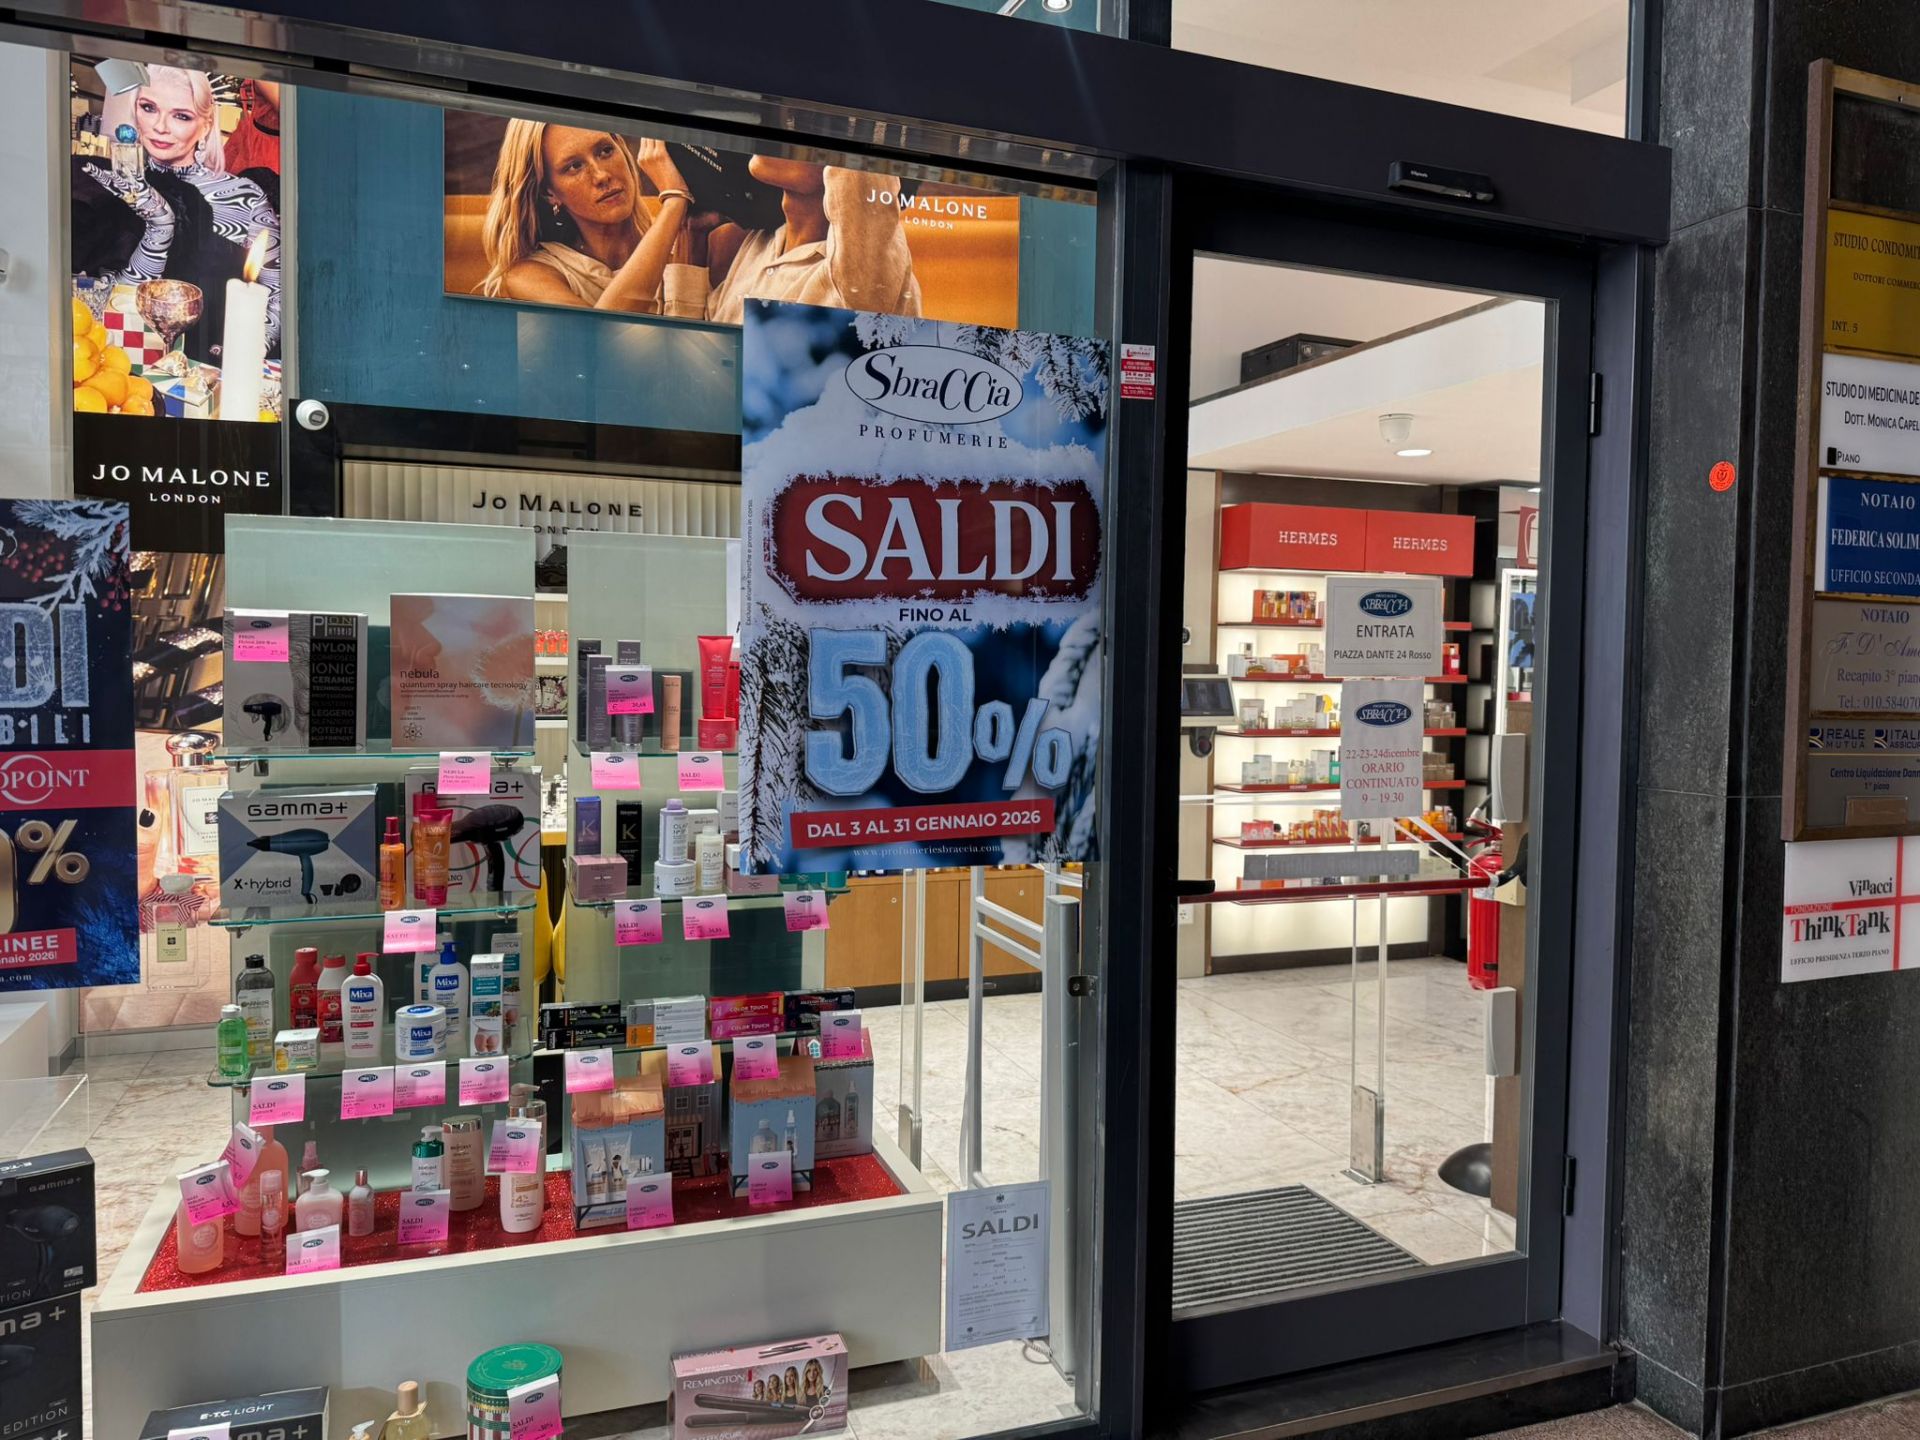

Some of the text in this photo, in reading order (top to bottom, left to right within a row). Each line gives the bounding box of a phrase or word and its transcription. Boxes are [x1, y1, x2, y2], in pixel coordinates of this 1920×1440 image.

[866, 189, 988, 219] JO MALONE
[905, 216, 954, 230] LONDON
[1833, 232, 1869, 251] STUDIO
[1832, 320, 1858, 333] INT. 5
[1825, 381, 1857, 399] STUDIO
[1858, 385, 1867, 400] DI
[1868, 386, 1909, 404] MEDICINA
[859, 423, 1009, 449] PROFUMERIE
[92, 464, 271, 488] JO MALONE
[149, 493, 222, 504] LONDON
[1860, 492, 1916, 511] NOTAIO
[804, 492, 1077, 582] SALDI
[1831, 528, 1885, 549] FEDERICA
[1831, 568, 1872, 585] UFFICIO
[899, 607, 973, 622] FINO AL
[1860, 608, 1910, 624] NOTAIO
[1356, 624, 1415, 639] ENTRATA
[311, 642, 356, 653] NYLON
[1333, 649, 1432, 661] PIAZZA DANTE 24 Rosso
[312, 662, 355, 675] IONIC
[400, 668, 440, 679] nebula
[311, 676, 355, 684] CERAMIC
[1837, 668, 1882, 686] Recapito
[400, 681, 435, 690] quantum
[436, 681, 458, 690] spray
[458, 681, 489, 689] haircare
[311, 709, 355, 717] LEGGERO
[804, 626, 1074, 797] 50%
[1359, 708, 1408, 723] SBRACCIA
[311, 726, 354, 735] POTENTE
[1826, 728, 1865, 739] REALE
[1826, 741, 1865, 749] MUTUA
[1361, 762, 1405, 774] ORARIO
[1830, 768, 1855, 778] Centro
[1856, 768, 1901, 780] Liquidazione
[1346, 776, 1420, 790] CONTINUATO
[1873, 782, 1890, 791] piano
[1362, 793, 1369, 803] 9
[807, 809, 1042, 839] DAL 3 AL 31 GENNAIO 2026
[622, 823, 637, 840] K
[853, 843, 1000, 857] www.profumeriesbraccia.com
[1849, 877, 1893, 897] Vinacci
[1789, 903, 1833, 914] FONDAZIONE
[1790, 948, 1890, 966] UFFICIO PRESIDENZA TERZO PIANO
[436, 977, 459, 987] Mixa
[350, 989, 374, 999] Mixa
[411, 1028, 433, 1037] Mixa
[252, 1101, 276, 1109] SALDI
[962, 1213, 1039, 1240] SALDI
[682, 1373, 745, 1391] REMINGTON
[234, 1403, 275, 1417] LIGHT
[3, 1406, 68, 1435] EDITION
